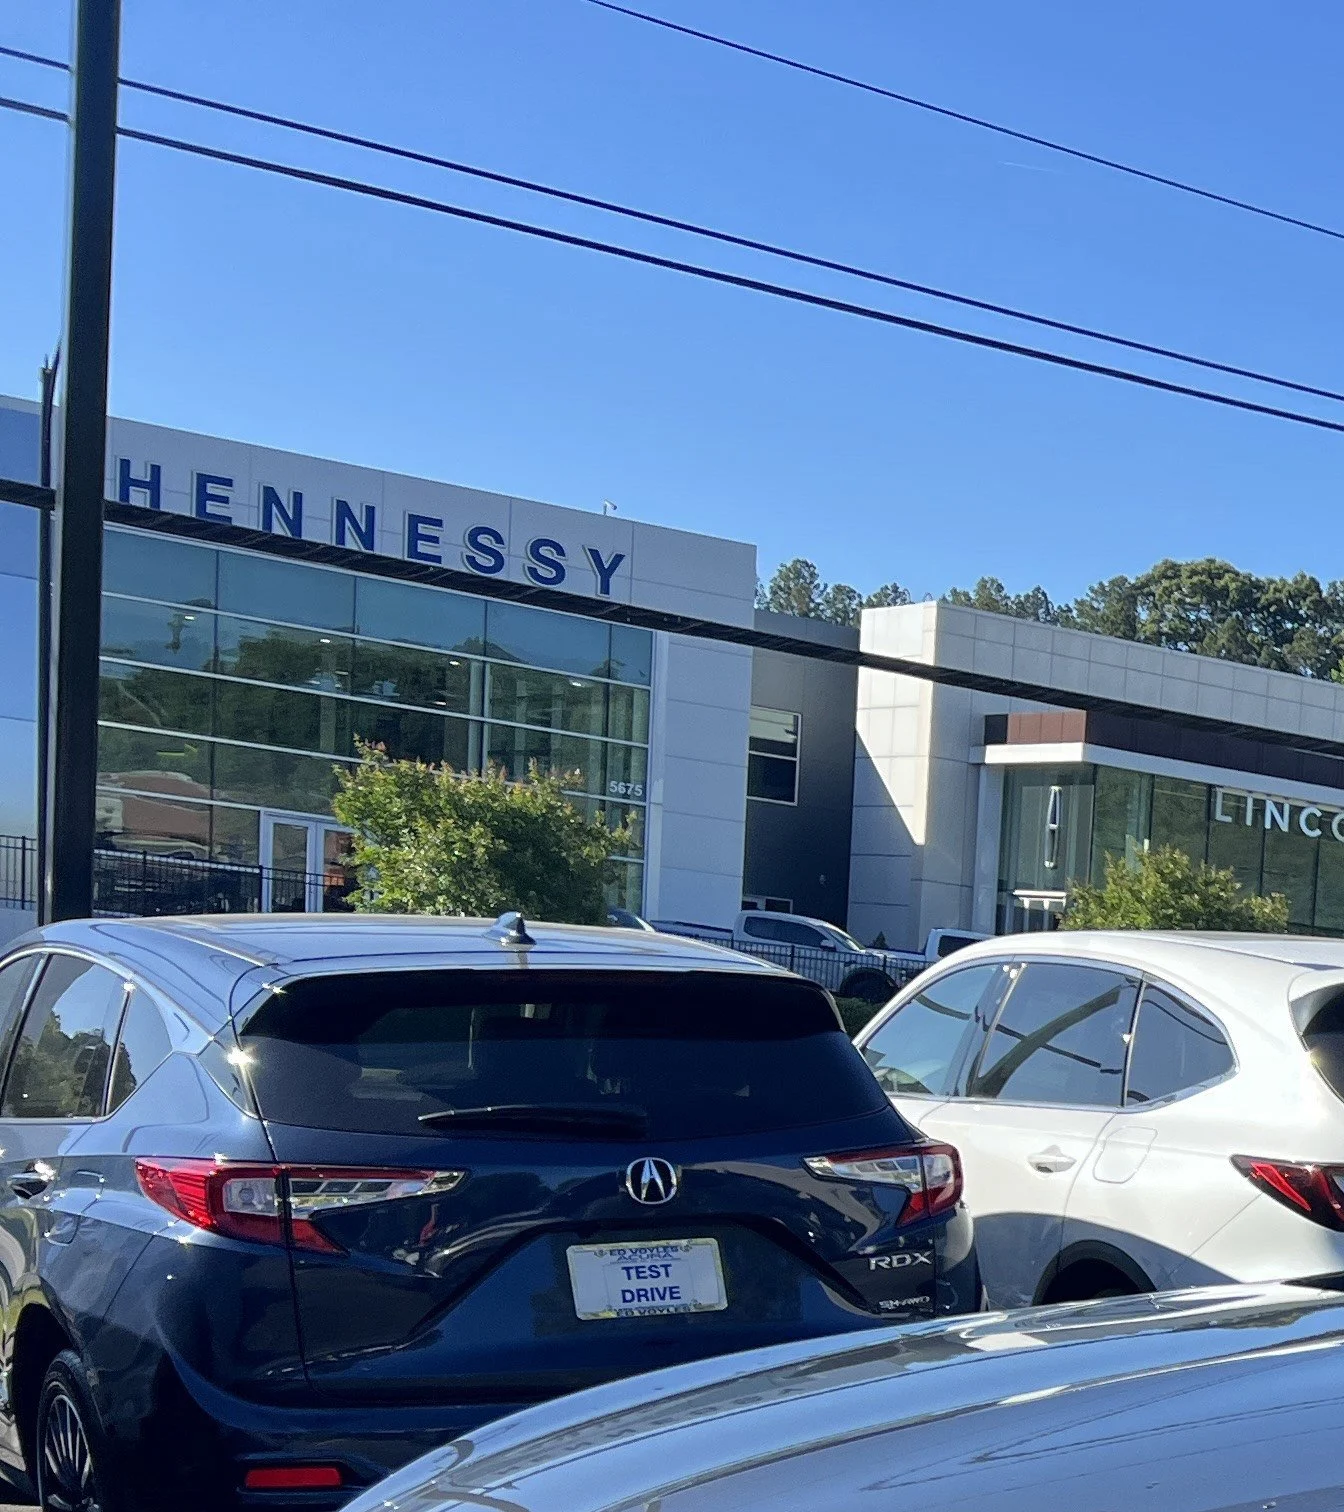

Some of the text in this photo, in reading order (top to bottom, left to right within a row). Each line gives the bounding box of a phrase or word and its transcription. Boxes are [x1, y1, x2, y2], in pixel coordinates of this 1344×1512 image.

[117, 457, 626, 597] HENNESSY
[609, 780, 643, 797] 5675
[869, 1250, 932, 1271] RDX
[621, 1263, 673, 1281] TEST
[621, 1285, 682, 1304] DRIVE
